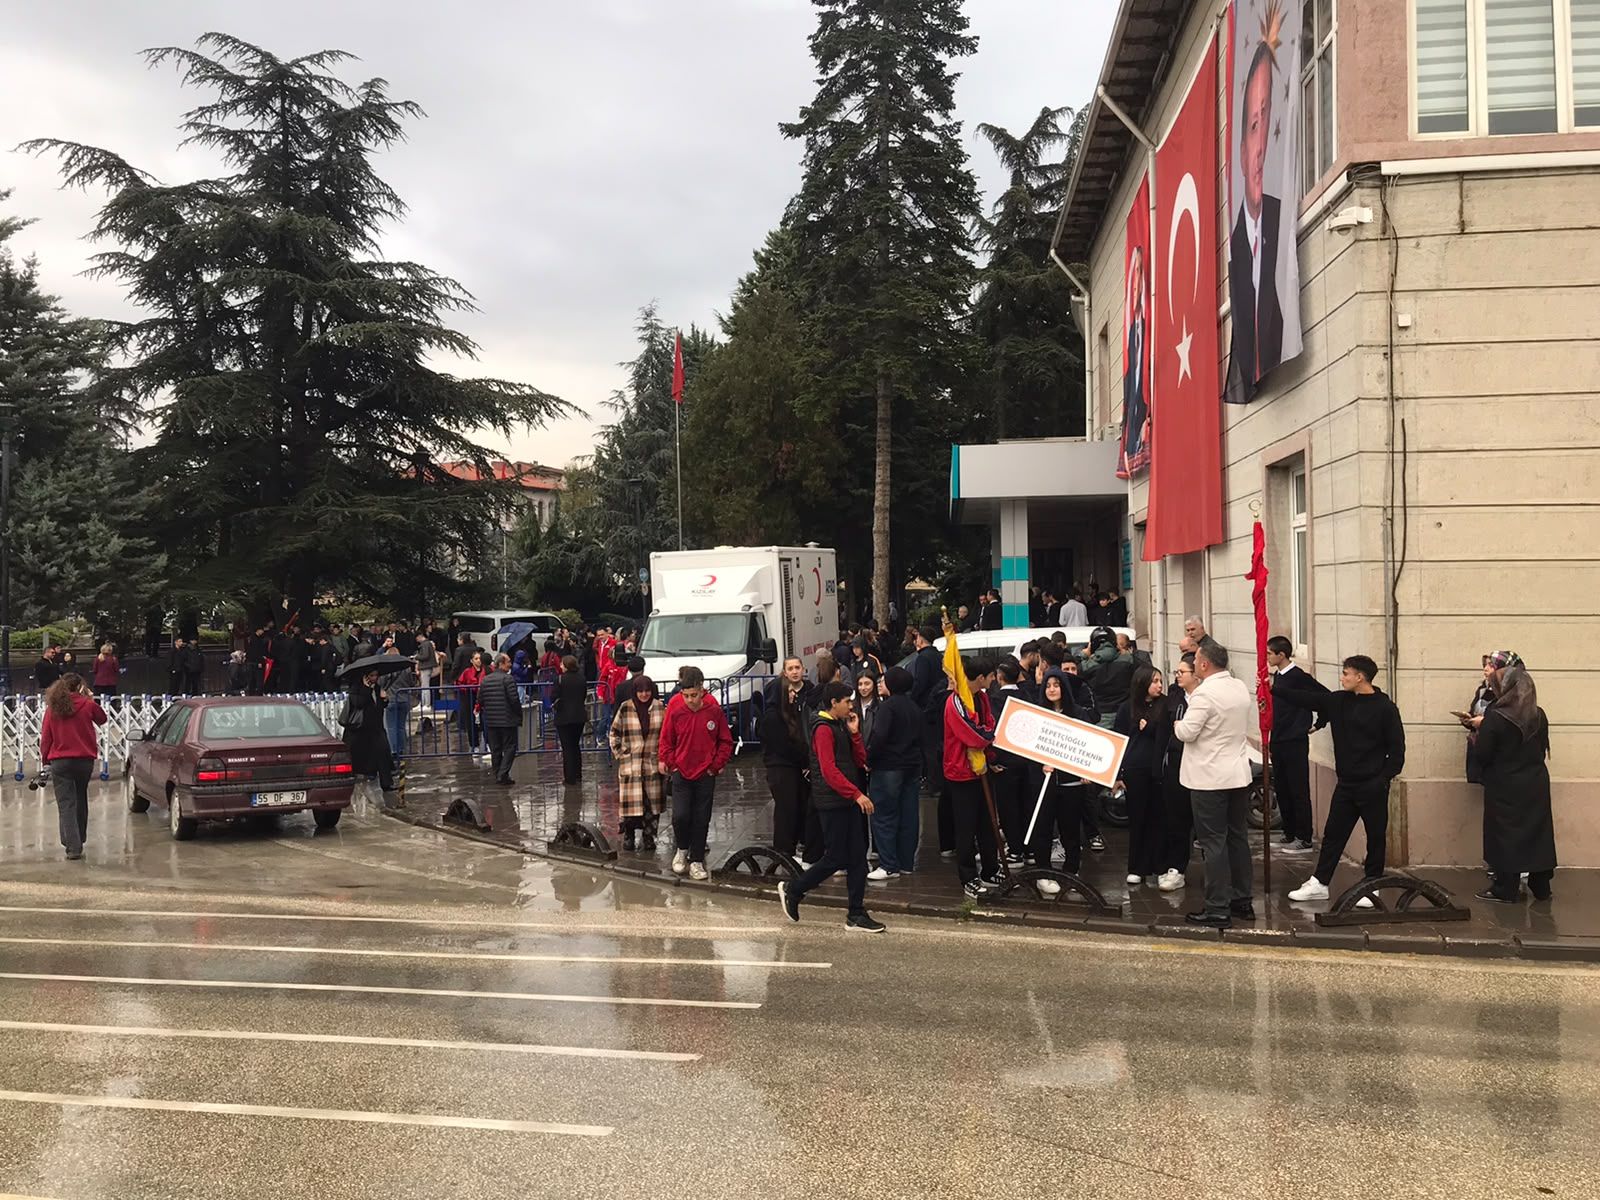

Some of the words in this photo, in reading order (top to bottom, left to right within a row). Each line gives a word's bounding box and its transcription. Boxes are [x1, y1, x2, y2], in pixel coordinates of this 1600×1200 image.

[1041, 727, 1087, 747] SEPETÇİOĞLU
[1034, 743, 1070, 760] ANADOLU
[1069, 754, 1092, 768] LİSESİ
[1068, 745, 1078, 754] VE
[1078, 748, 1104, 763] TEKNİK
[258, 793, 268, 803] 55
[274, 792, 284, 802] DF
[291, 791, 305, 801] 367
